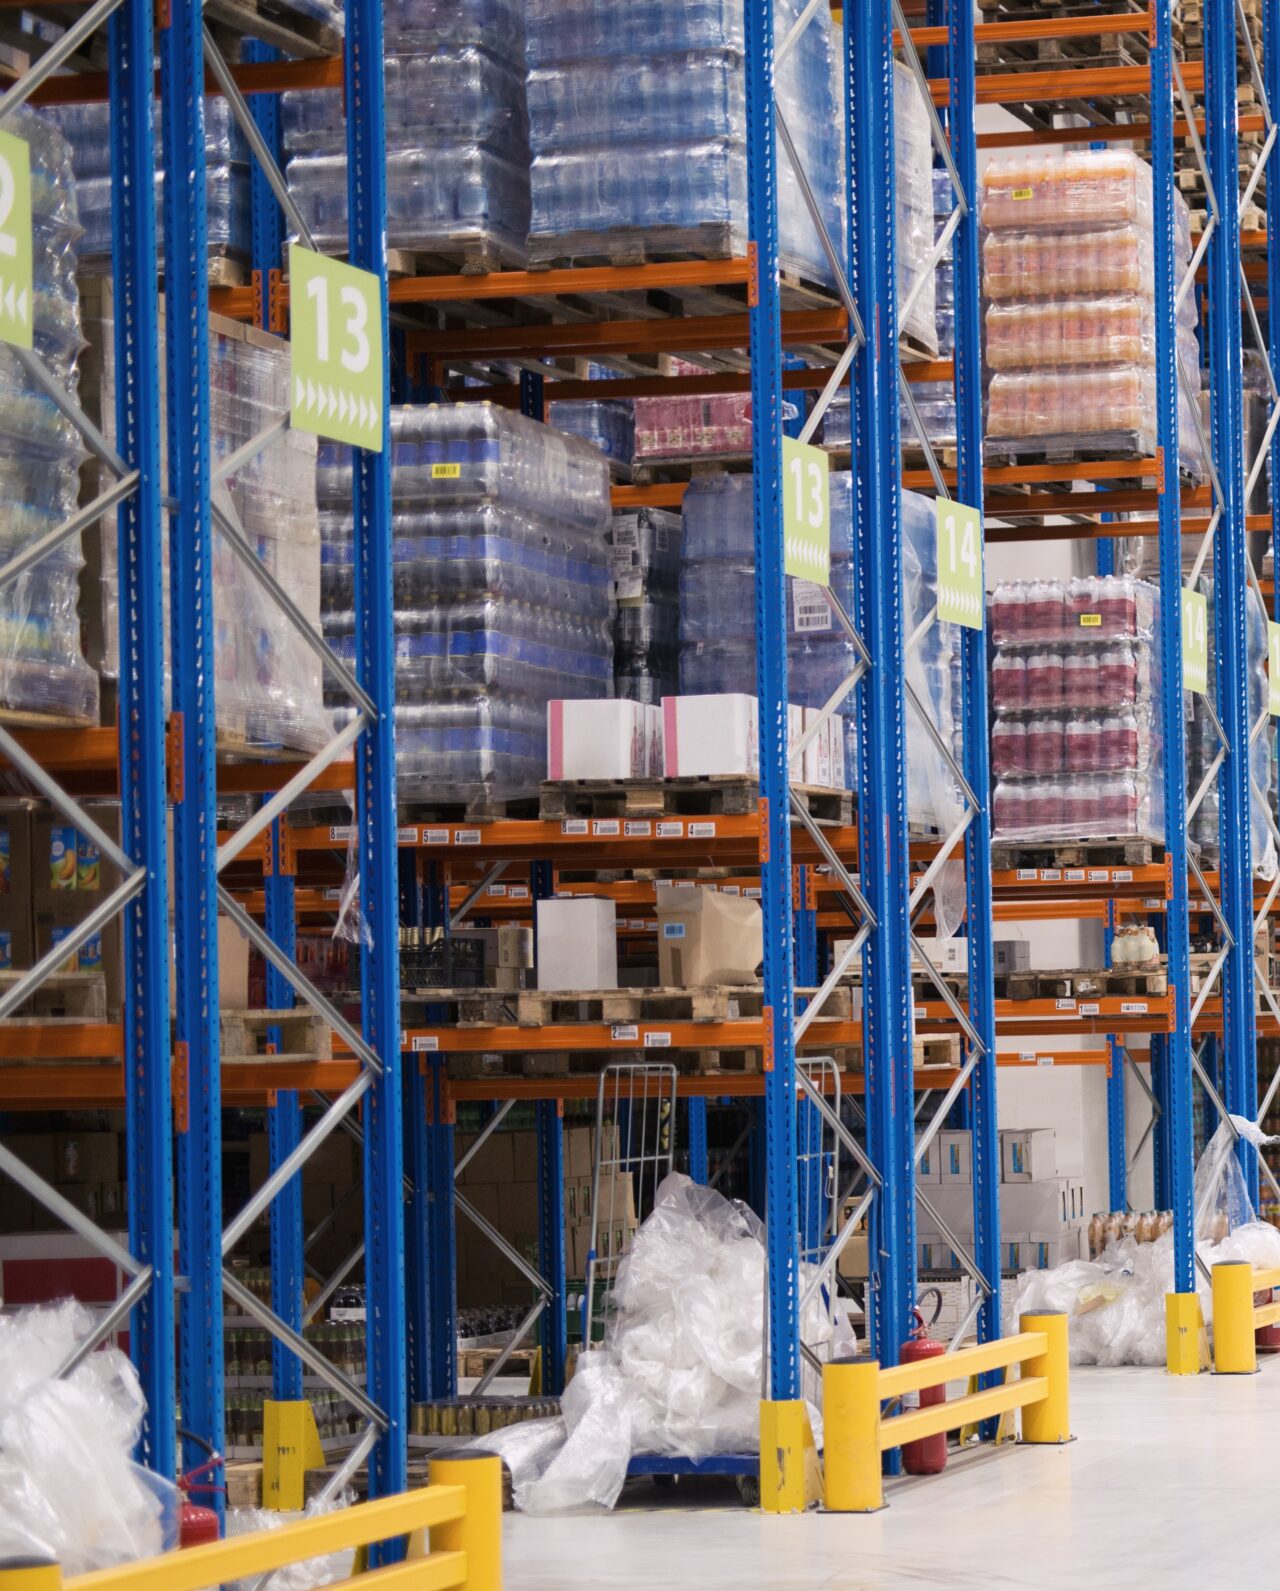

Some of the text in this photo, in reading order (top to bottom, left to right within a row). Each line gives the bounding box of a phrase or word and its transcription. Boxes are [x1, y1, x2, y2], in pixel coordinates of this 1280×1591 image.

[307, 275, 370, 373] 13
[790, 457, 824, 528] 13
[945, 515, 977, 578] 14
[1186, 601, 1205, 653] 14
[562, 820, 567, 833] 8
[593, 822, 598, 834] 7
[625, 823, 630, 835] 6
[657, 824, 662, 836] 5
[689, 824, 694, 836] 4
[330, 829, 336, 840] 8
[423, 830, 429, 842] 5
[455, 831, 461, 842] 4
[612, 1026, 617, 1039] 2
[413, 1037, 418, 1050] 1
[645, 1034, 650, 1045] 1
